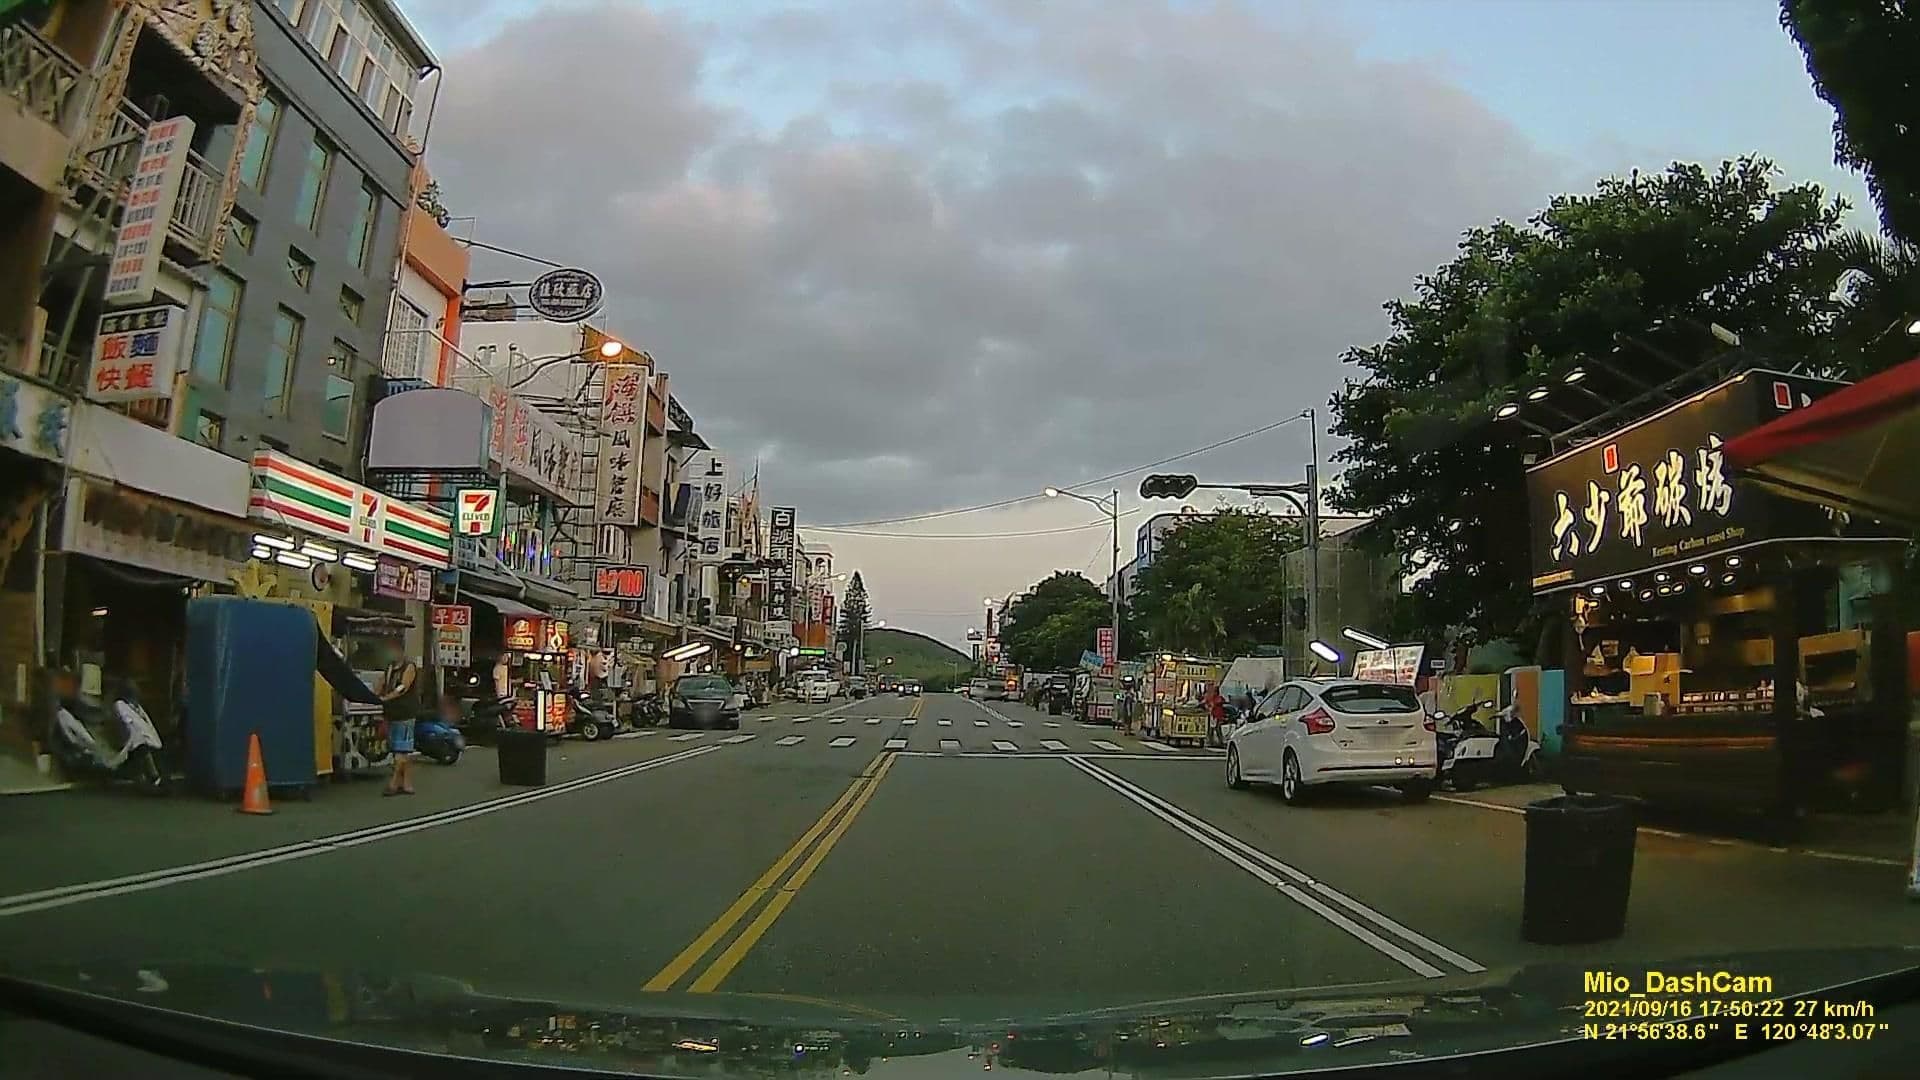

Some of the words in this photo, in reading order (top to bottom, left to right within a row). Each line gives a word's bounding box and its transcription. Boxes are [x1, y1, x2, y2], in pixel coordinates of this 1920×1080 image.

[97, 364, 153, 391] 快餐
[703, 457, 723, 555] 上好旅店
